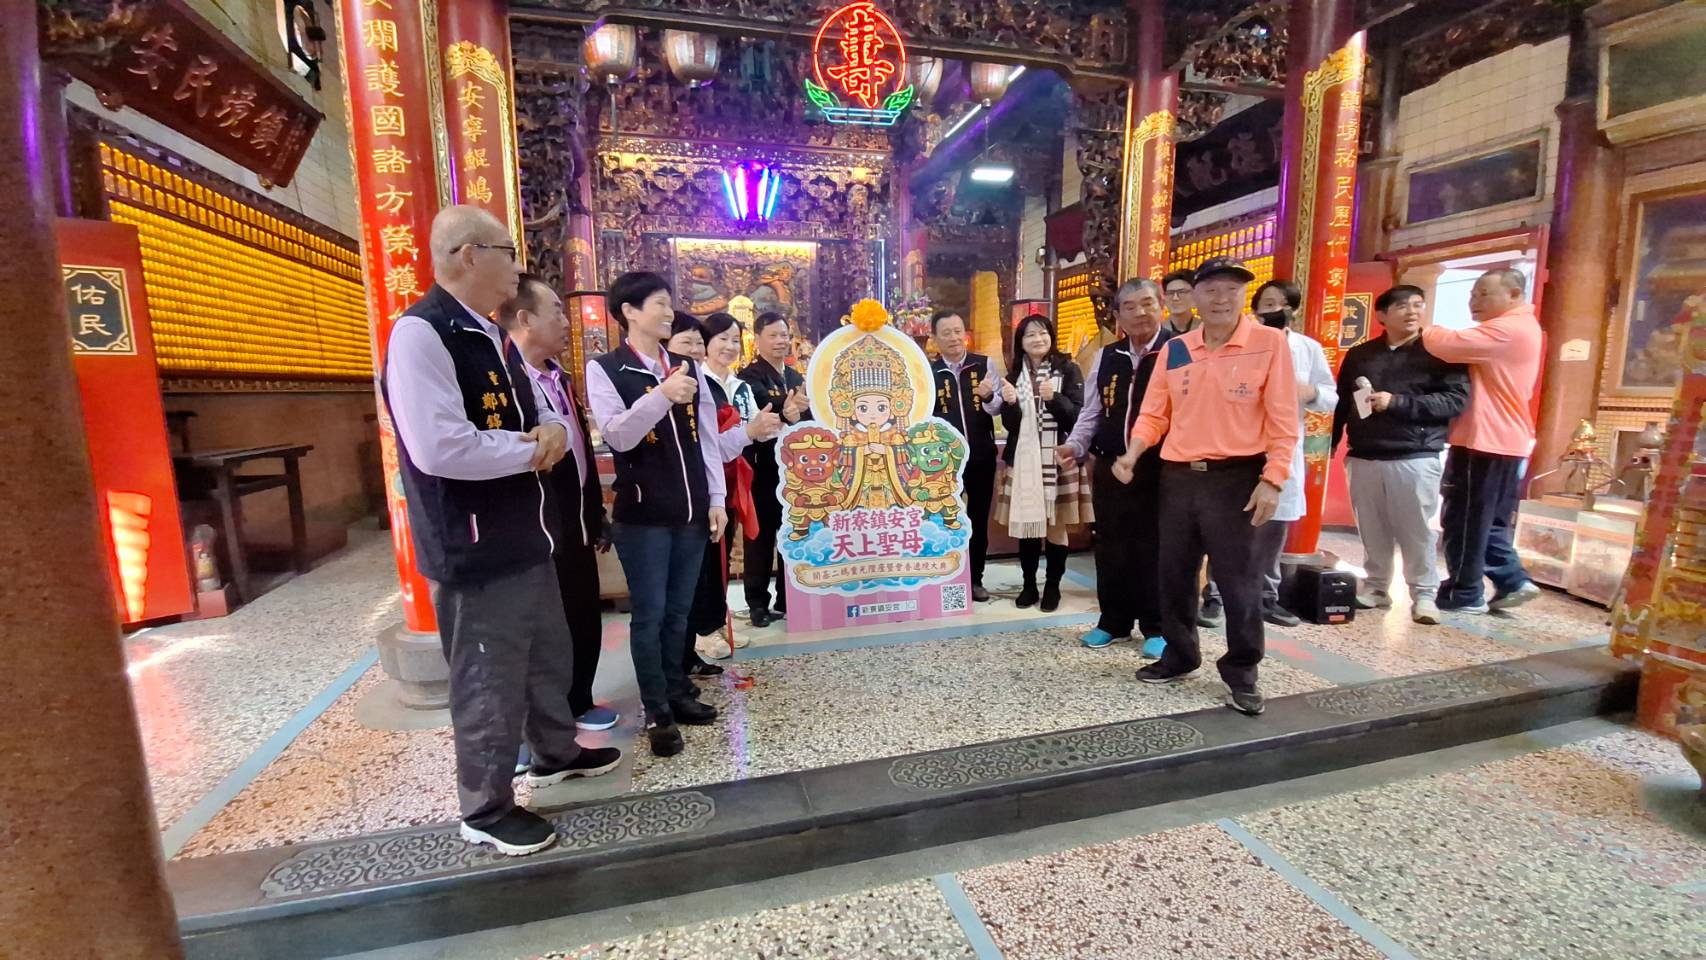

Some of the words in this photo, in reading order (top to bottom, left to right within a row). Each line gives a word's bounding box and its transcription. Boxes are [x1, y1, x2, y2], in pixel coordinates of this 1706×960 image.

[362, 0, 424, 319] 瀾護國諸方榮獲
[70, 283, 113, 336] 佑民
[832, 508, 922, 532] 新寮鎮安宮
[831, 529, 924, 559] 天上聖母
